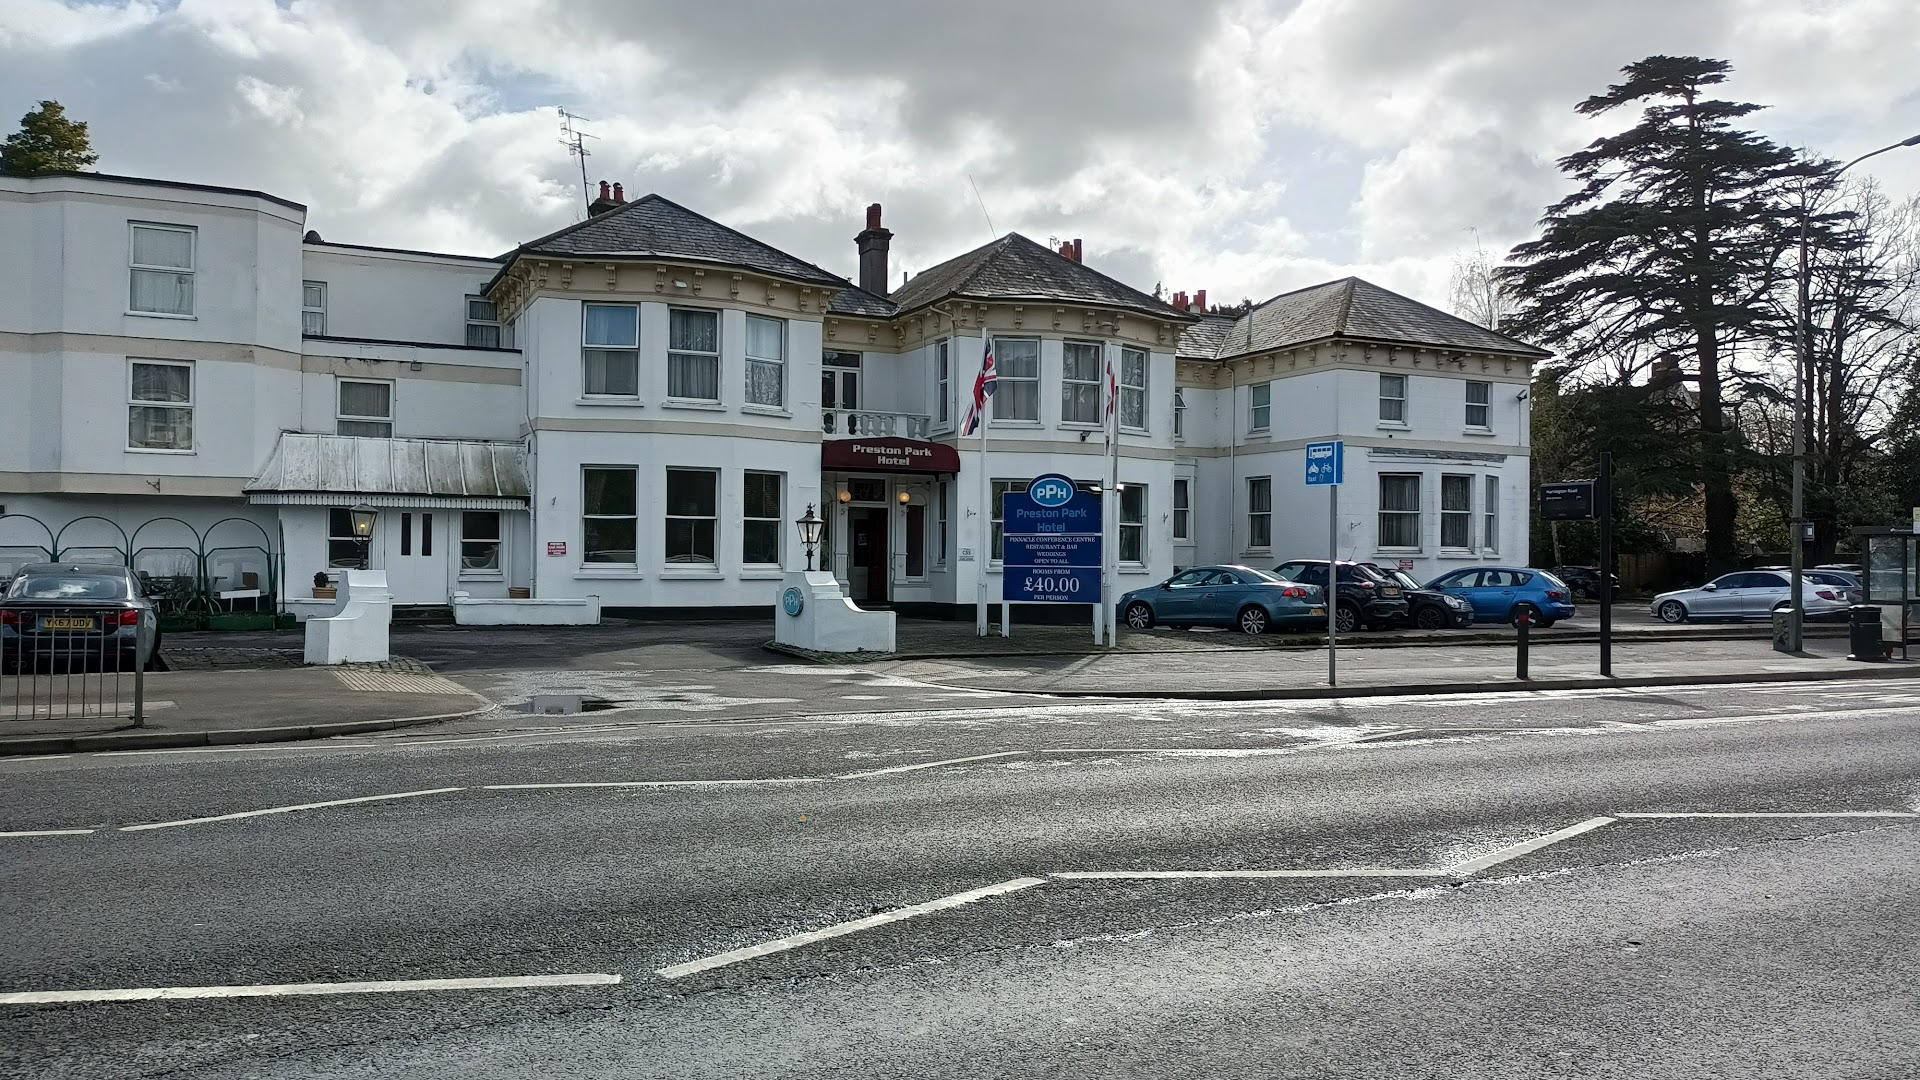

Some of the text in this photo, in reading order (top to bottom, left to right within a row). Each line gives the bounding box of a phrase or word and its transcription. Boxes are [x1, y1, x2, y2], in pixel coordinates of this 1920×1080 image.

[852, 444, 933, 457] Preston Park
[877, 455, 910, 466] Hotel
[1036, 484, 1067, 499] PPH
[1016, 507, 1087, 519] Preston Park
[1037, 522, 1066, 532] Hotel
[1023, 576, 1080, 593] £40.00
